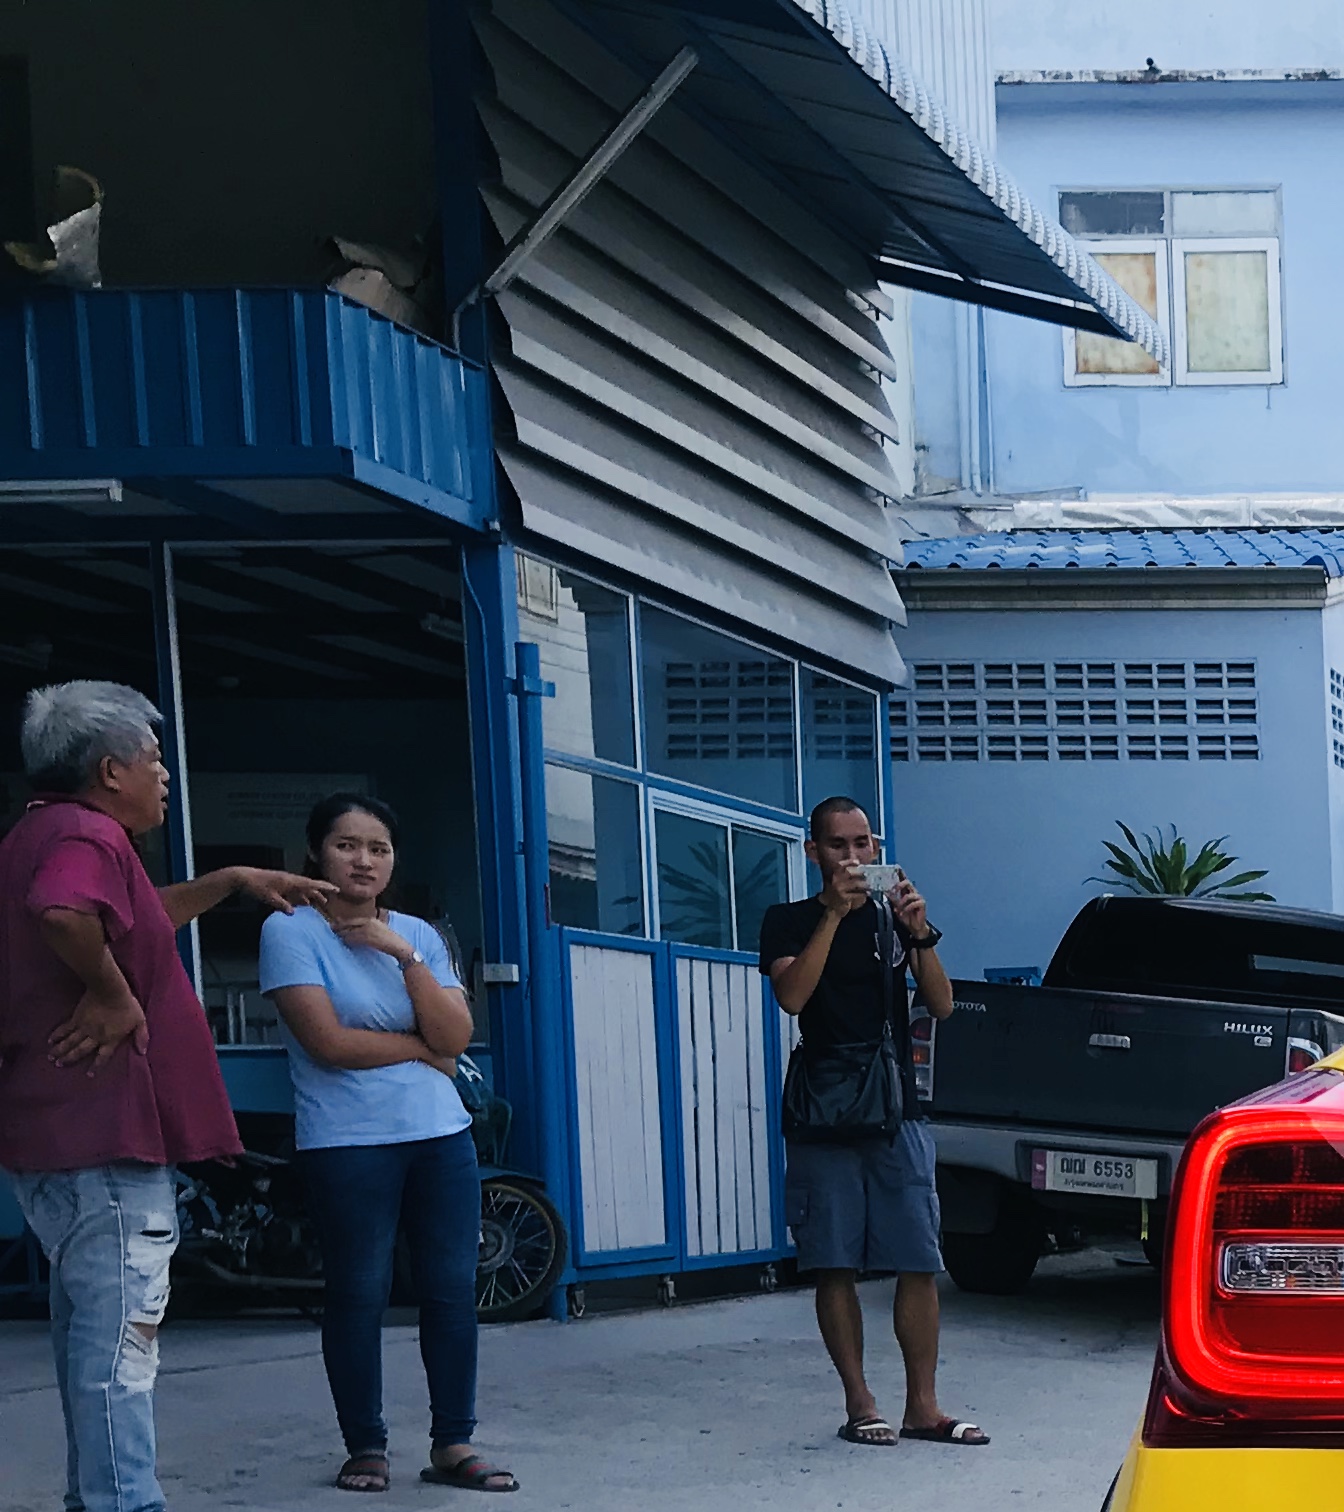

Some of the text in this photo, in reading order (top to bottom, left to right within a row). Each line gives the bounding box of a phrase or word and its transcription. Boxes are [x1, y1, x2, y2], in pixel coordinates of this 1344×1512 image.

[951, 1001, 986, 1012] OYOTA
[1224, 1021, 1273, 1036] HILUX
[1093, 1160, 1134, 1179] 6553
